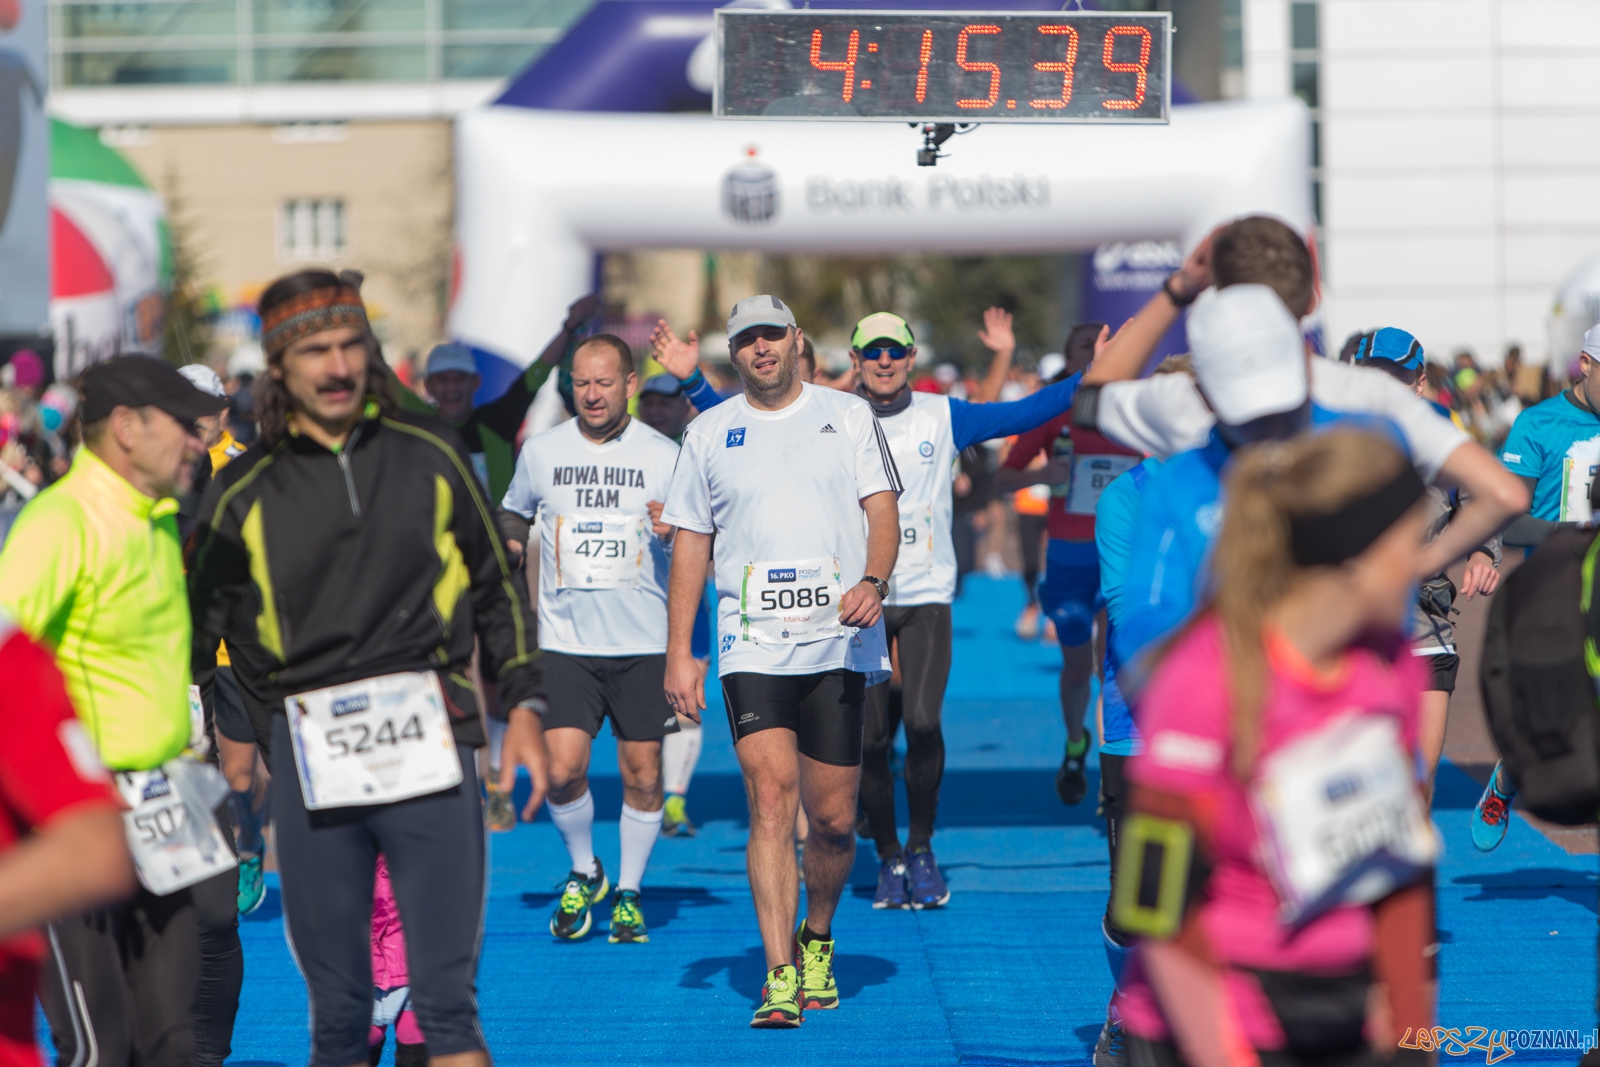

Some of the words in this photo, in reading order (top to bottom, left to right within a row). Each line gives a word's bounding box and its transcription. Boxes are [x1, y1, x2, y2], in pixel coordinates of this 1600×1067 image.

[805, 175, 911, 212] Bank
[928, 173, 1050, 212] Polski
[553, 465, 599, 486] NOWA
[603, 466, 645, 489] HUTA
[575, 488, 619, 508] TEAM
[575, 539, 626, 558] 4731
[761, 586, 830, 610] 5086
[325, 711, 425, 760] 5244
